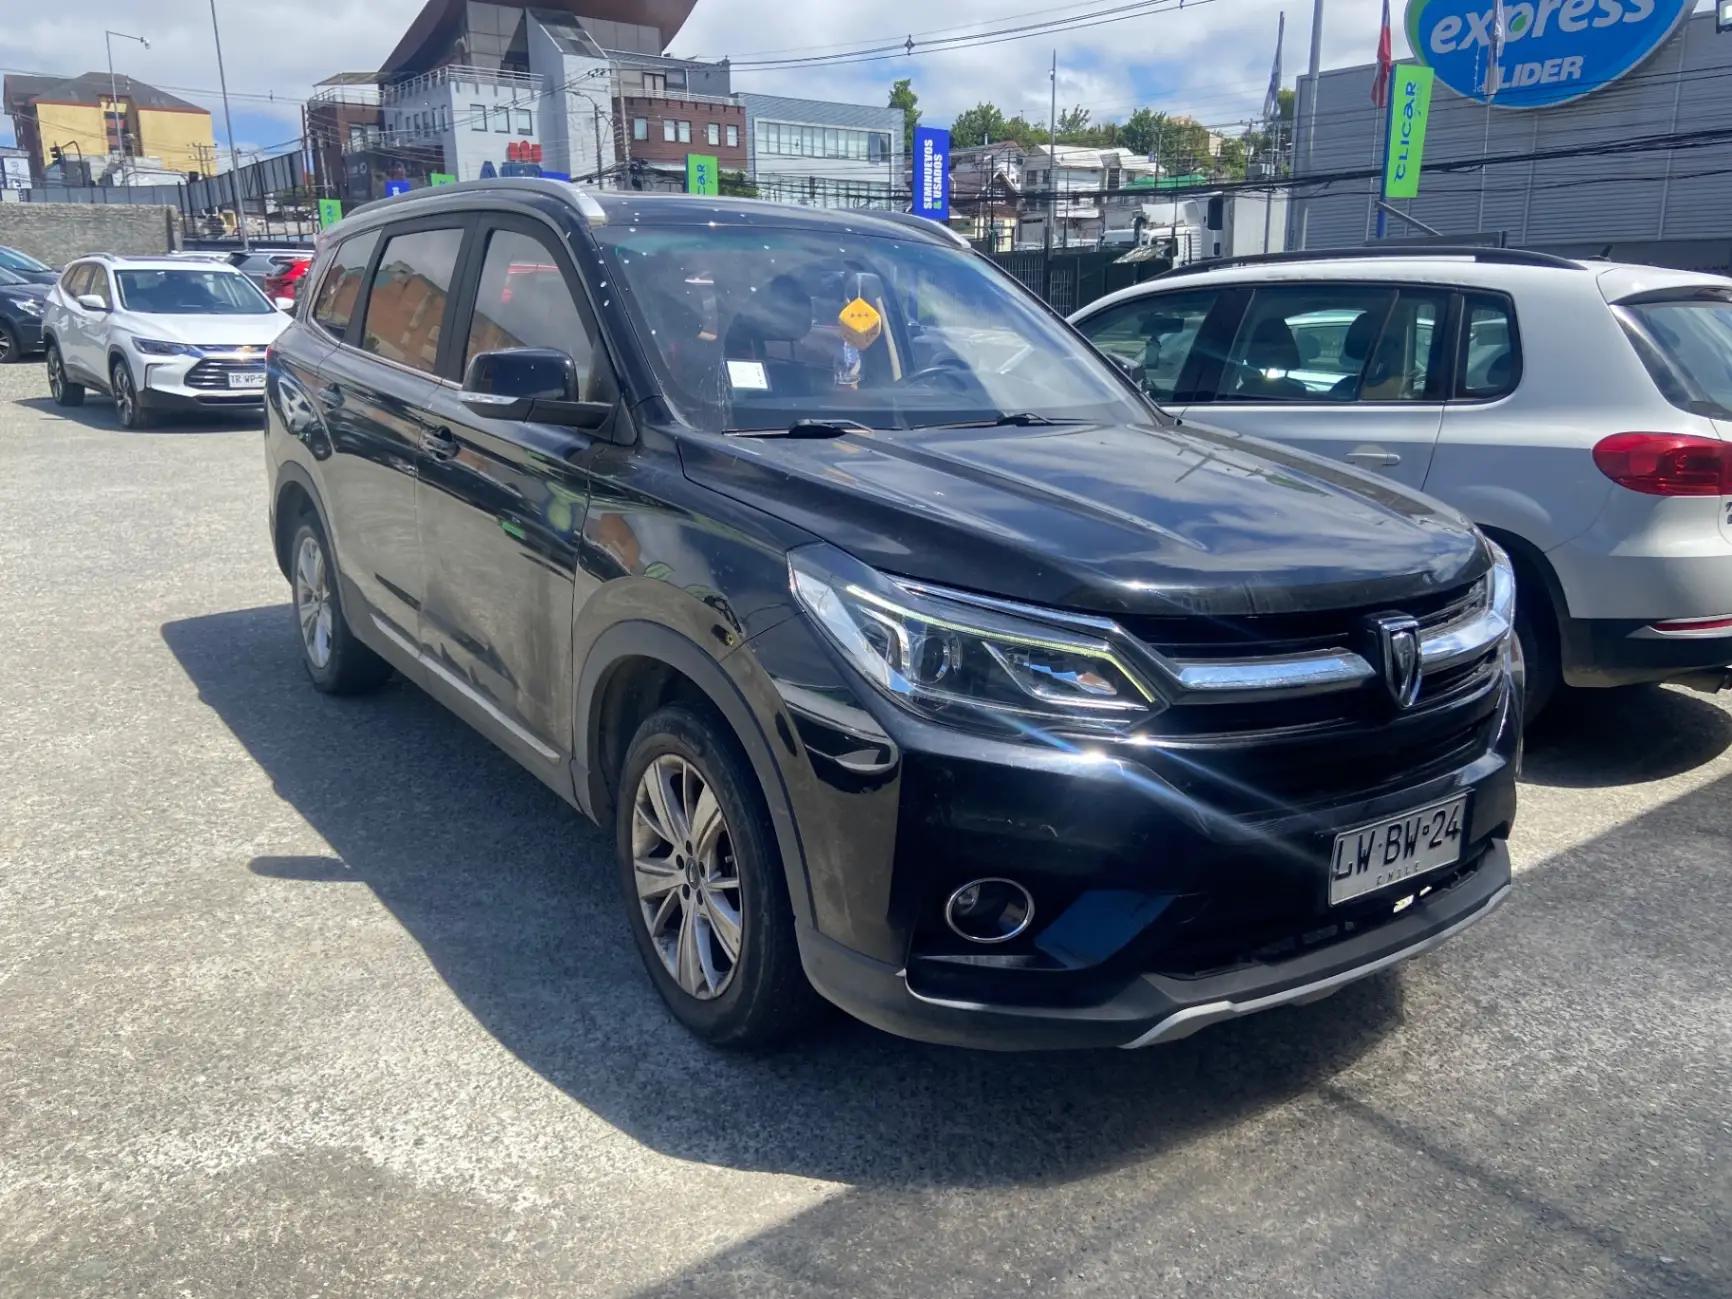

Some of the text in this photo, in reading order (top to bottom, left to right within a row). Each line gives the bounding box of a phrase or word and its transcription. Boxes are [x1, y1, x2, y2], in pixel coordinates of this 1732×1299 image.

[1430, 0, 1655, 57] express
[1495, 55, 1584, 90] LIDER
[924, 139, 933, 209] SEMINUEVOS
[933, 154, 942, 198] USADOS
